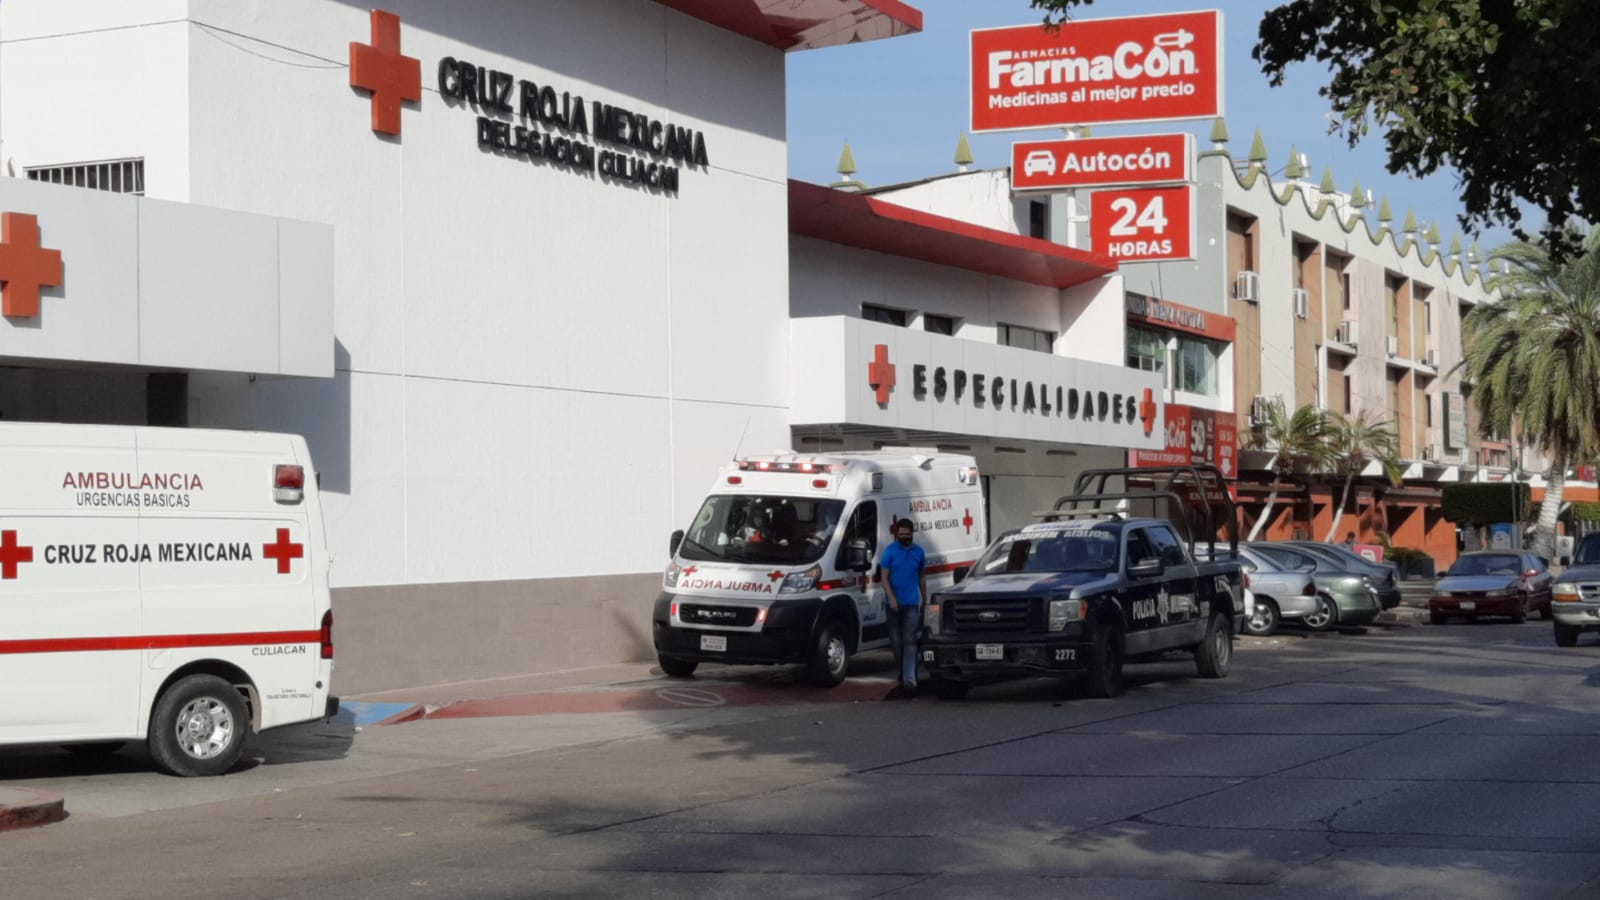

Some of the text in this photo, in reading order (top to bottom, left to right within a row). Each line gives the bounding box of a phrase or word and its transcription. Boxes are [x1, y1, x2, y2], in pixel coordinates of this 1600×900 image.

[988, 80, 1195, 109] Medicinas al mejor precio
[438, 56, 709, 167] CRUZ ROJA MEXICANA
[477, 116, 595, 172] DELEGACION
[1062, 147, 1171, 174] Autocón
[1109, 195, 1168, 237] 24
[1108, 239, 1172, 258] HORAS
[913, 363, 1137, 424] ESPECIALIDADES
[62, 471, 204, 491] AMBULANCIA
[76, 491, 191, 508] URGENCIAS BASICAS
[44, 541, 253, 564] CRUZ ROJA MEXICANA
[251, 645, 306, 657] CULIACAN
